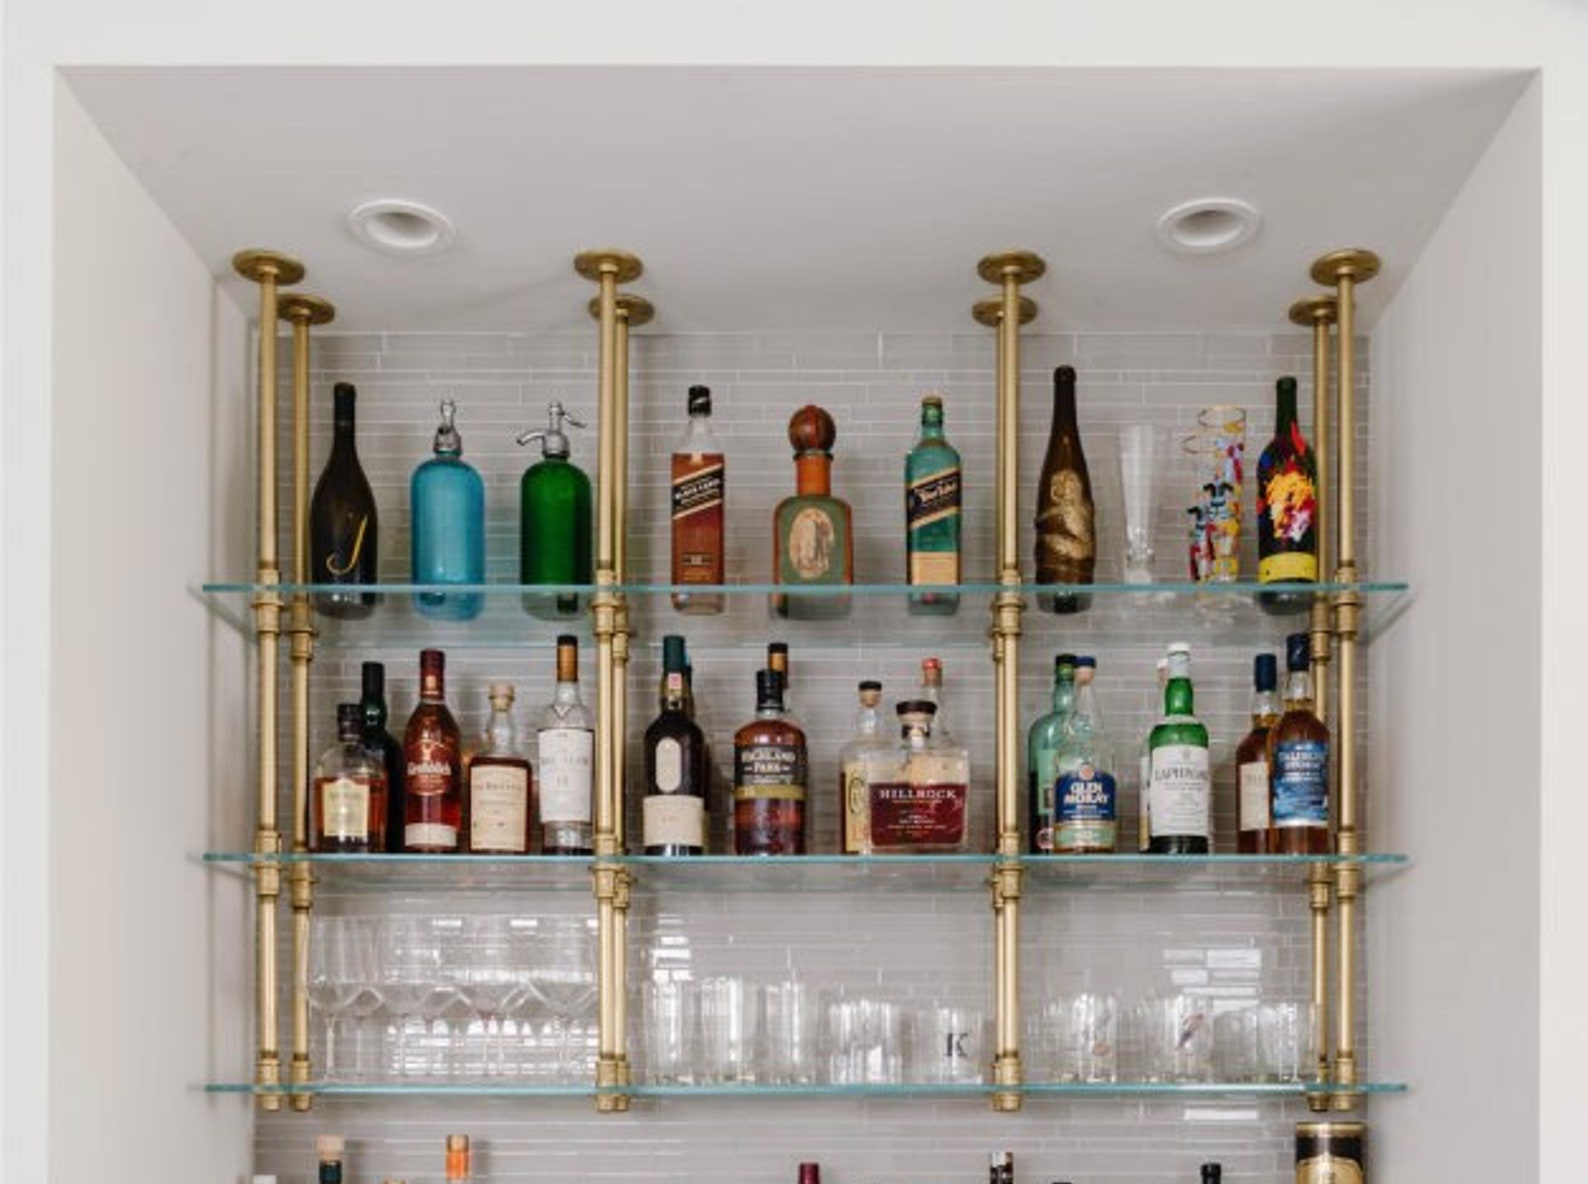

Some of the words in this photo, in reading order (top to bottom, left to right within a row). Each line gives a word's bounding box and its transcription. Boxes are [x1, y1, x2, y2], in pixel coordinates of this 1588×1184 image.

[741, 747, 796, 763] HIGHLAND
[754, 761, 781, 773] PARK
[1070, 781, 1103, 793] GLEN
[878, 789, 957, 799] HILLROCK
[1063, 793, 1110, 806] MORAY
[944, 1033, 969, 1058] K
